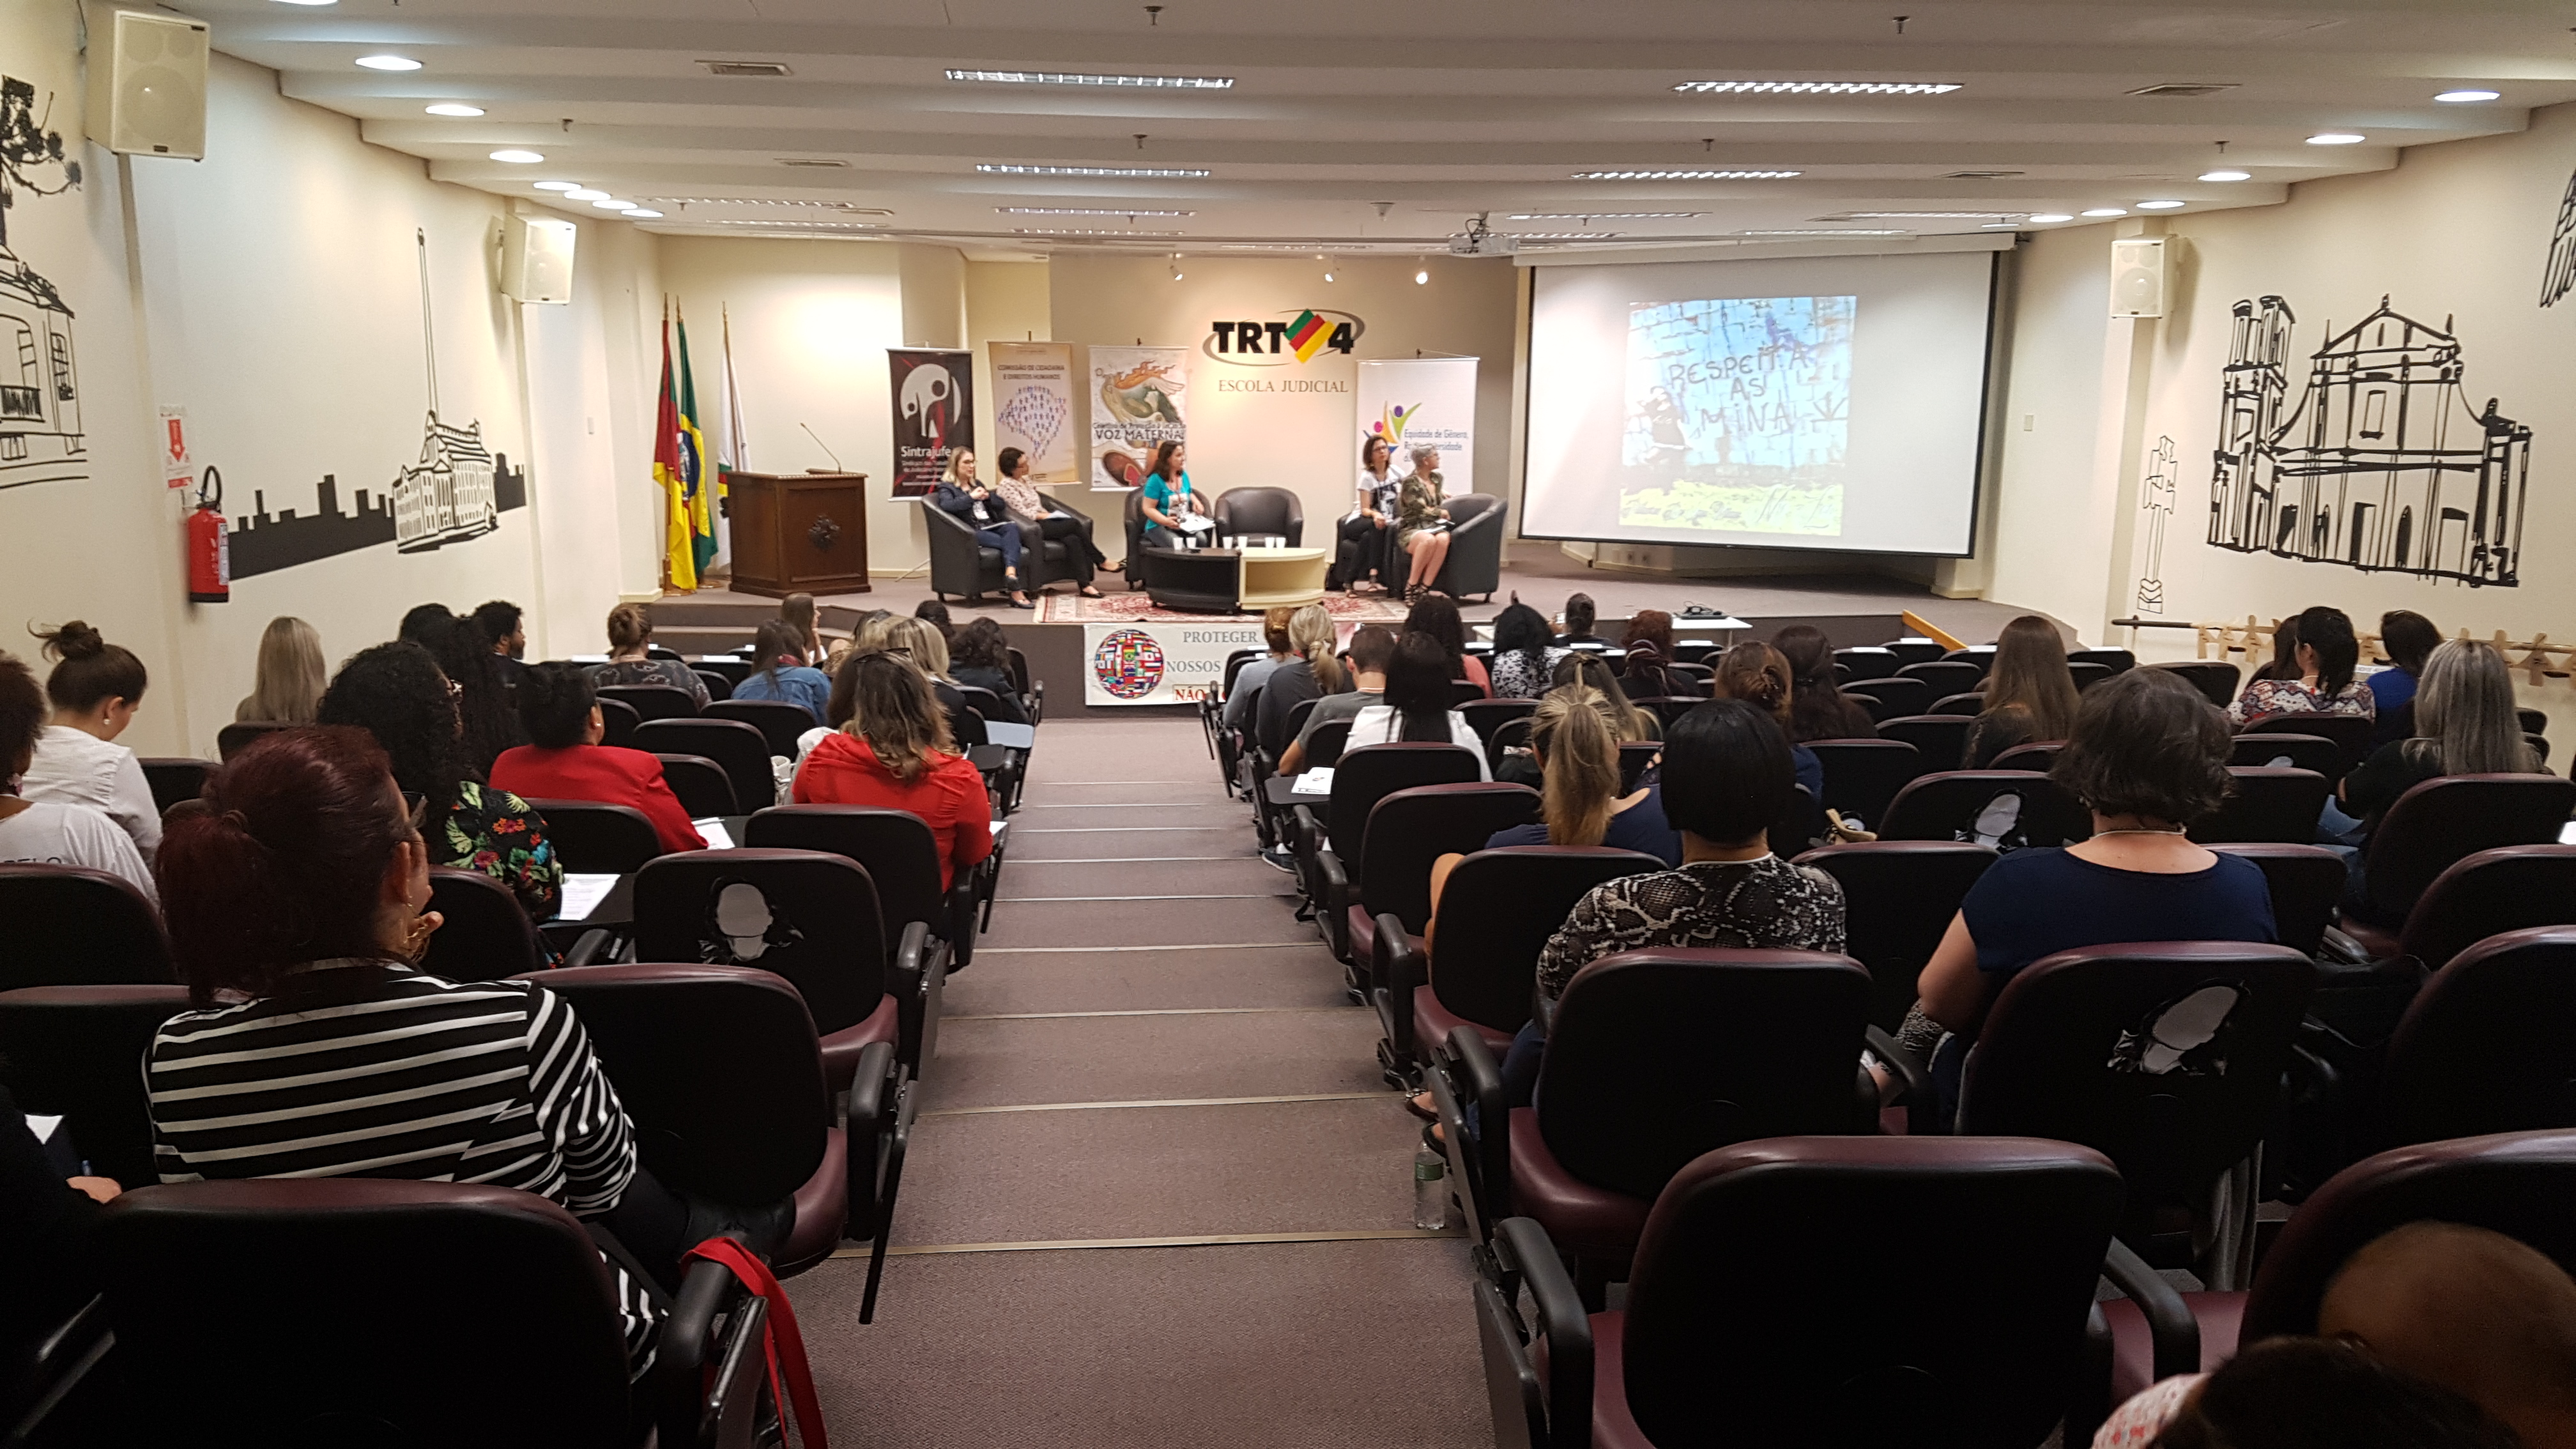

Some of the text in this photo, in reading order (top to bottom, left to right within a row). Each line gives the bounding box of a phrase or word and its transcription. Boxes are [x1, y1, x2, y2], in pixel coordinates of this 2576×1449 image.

[1212, 321, 1354, 354] TRT 4
[1218, 380, 1349, 394] ESCOLA JUDICIAL
[1095, 429, 1122, 440] VOZ
[901, 445, 952, 459] Sintrajufe
[1183, 631, 1259, 643] PROTEGER
[1166, 661, 1222, 673] NOSSOS
[1175, 686, 1206, 702] NÃO
